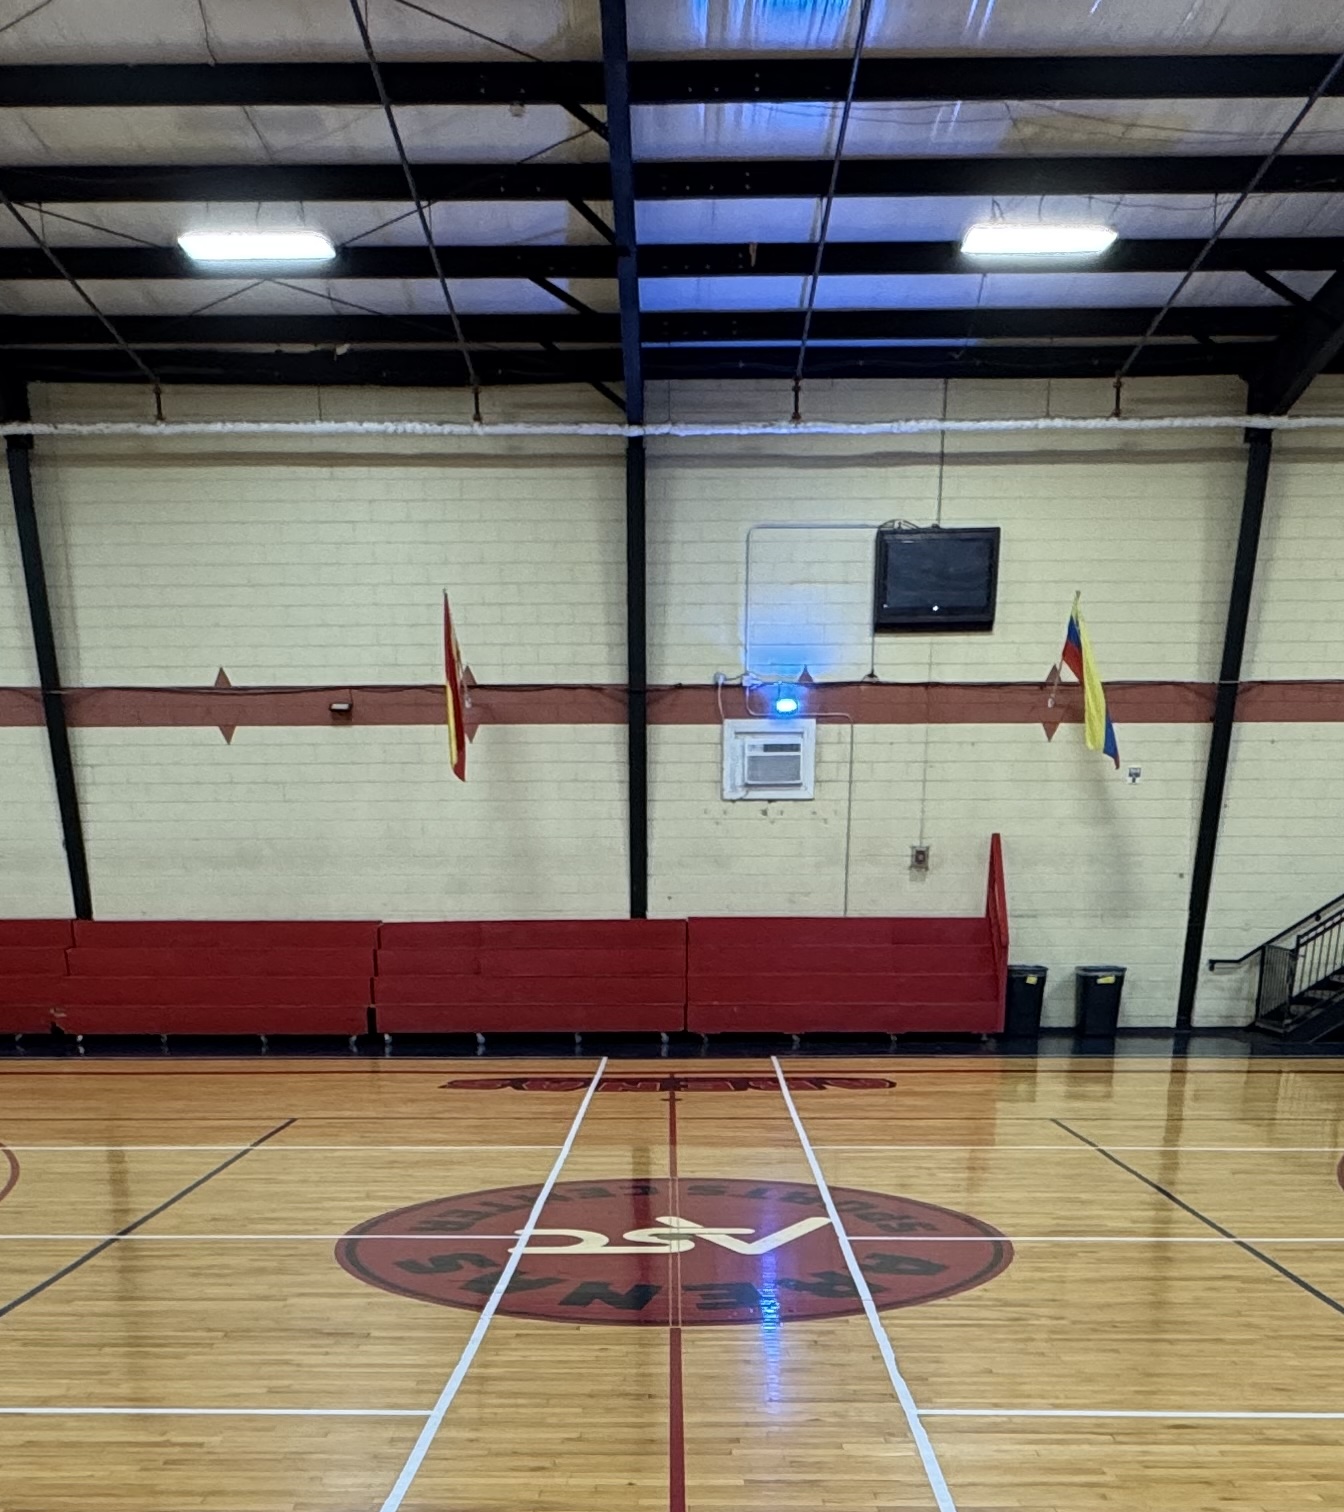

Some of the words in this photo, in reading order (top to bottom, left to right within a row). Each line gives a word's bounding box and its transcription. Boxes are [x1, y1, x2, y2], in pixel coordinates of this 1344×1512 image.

[687, 1184, 939, 1232] SPORTS
[508, 1216, 834, 1255] ASC
[392, 1252, 949, 1312] ARENAS
